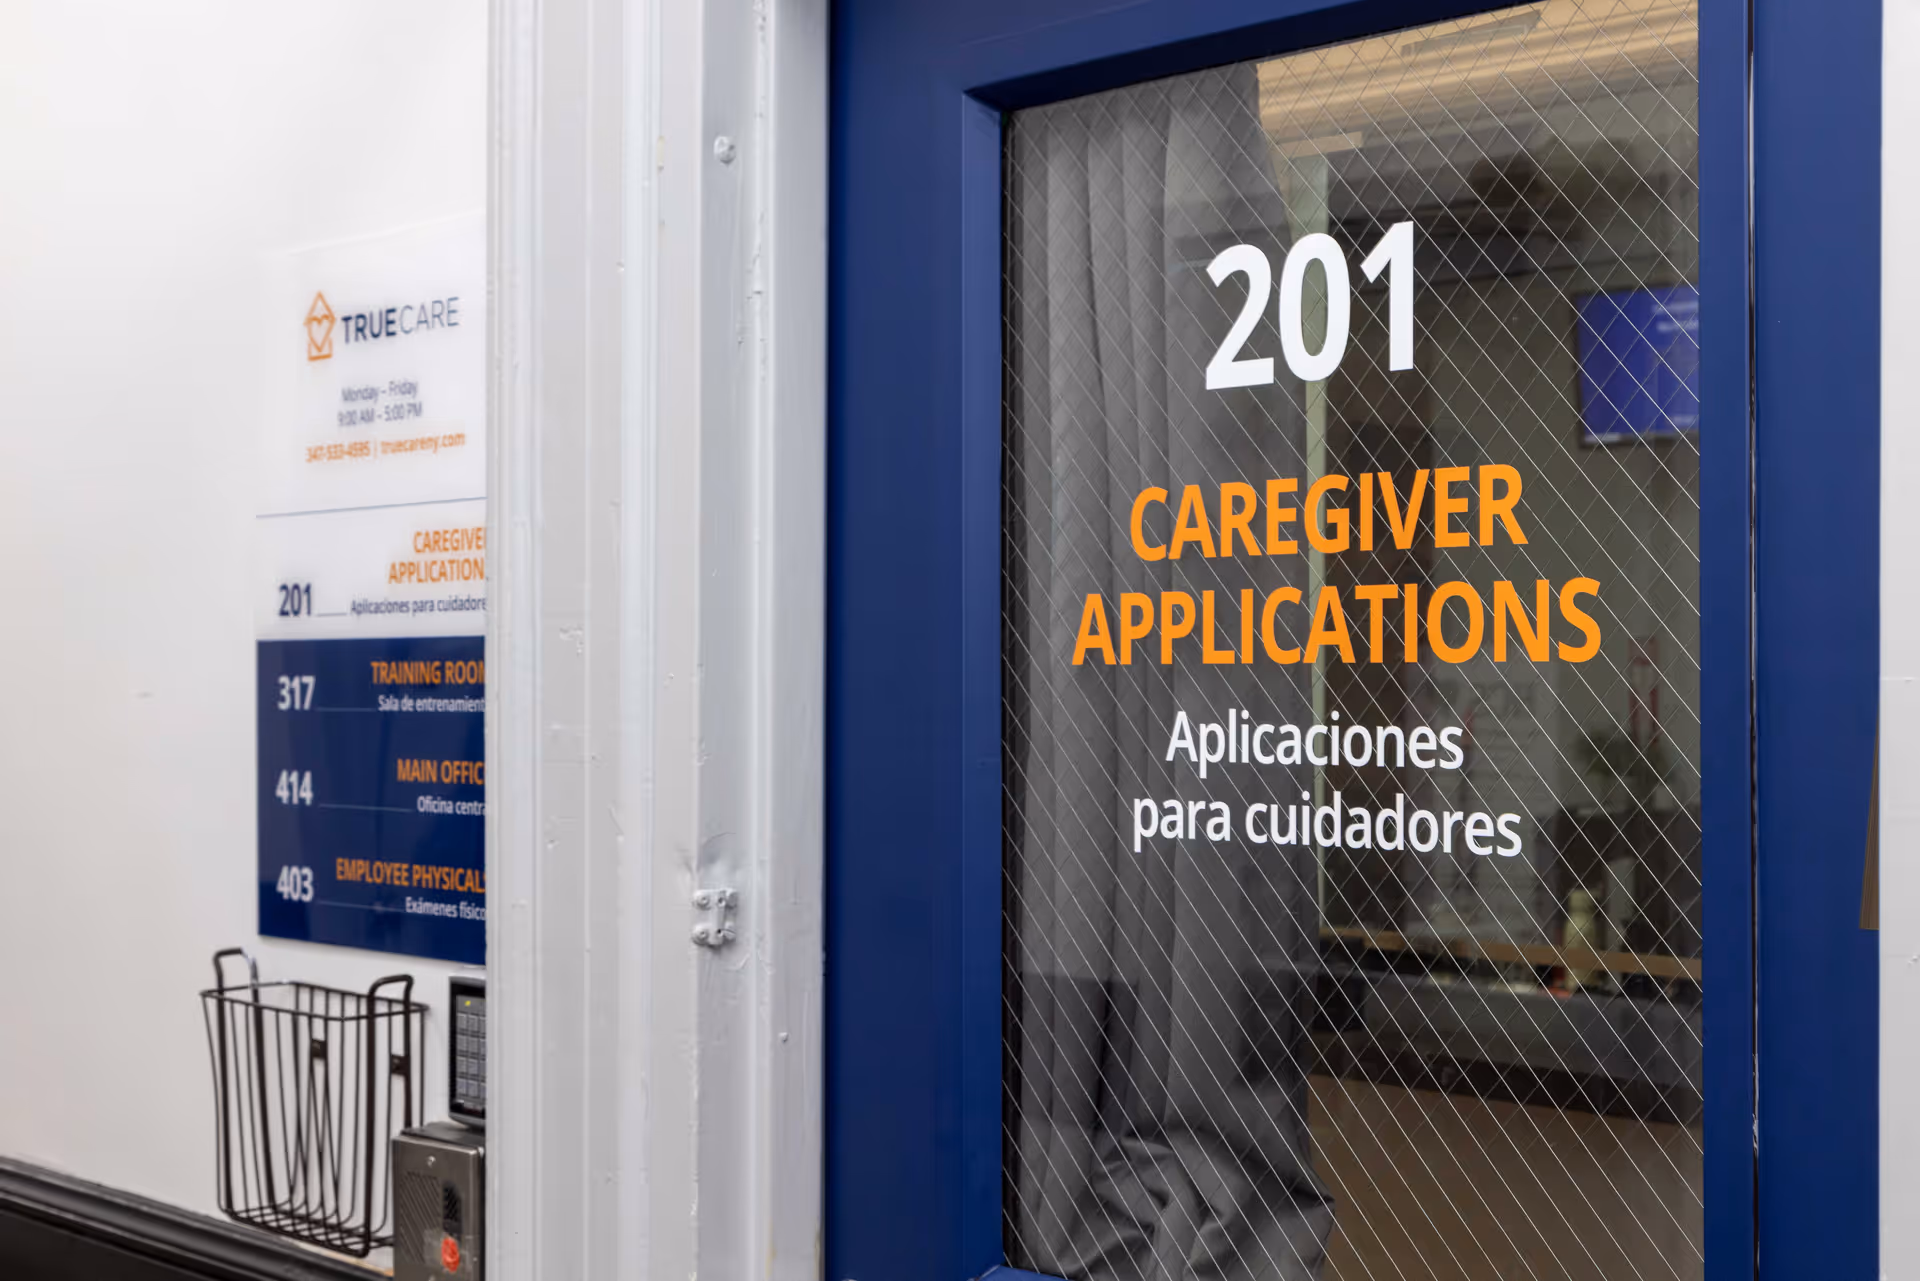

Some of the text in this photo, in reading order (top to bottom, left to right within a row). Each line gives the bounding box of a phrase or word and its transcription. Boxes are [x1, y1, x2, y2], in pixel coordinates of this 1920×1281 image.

[341, 296, 460, 344] TRUECARE
[1206, 221, 1414, 390] 201
[342, 385, 379, 404] Monday
[388, 380, 418, 400] Friday
[338, 409, 357, 426] 9:00
[360, 407, 375, 422] AM
[384, 402, 404, 421] 5:00
[406, 401, 422, 418] PM
[380, 432, 465, 454] truecareny.com
[1130, 463, 1528, 561] CAREGIVER
[413, 527, 486, 553] CAREGIVE
[278, 583, 312, 617] 201
[350, 597, 409, 616] Aplicaciones
[412, 598, 434, 616] para
[1072, 577, 1602, 666] APPLICATIONS
[371, 660, 441, 685] TRAINING
[277, 675, 316, 710] 317
[378, 694, 398, 712] Sala
[400, 694, 413, 711] de
[1166, 708, 1464, 778] Aplicaciones
[275, 769, 313, 805] 414
[397, 758, 437, 783] MAIN
[417, 795, 453, 814] Oficina
[1133, 790, 1523, 857] para cuidadores
[276, 865, 313, 901] 403
[336, 858, 486, 894] EMPLOYEE PHYSICAL
[405, 896, 458, 918] Exámenes
